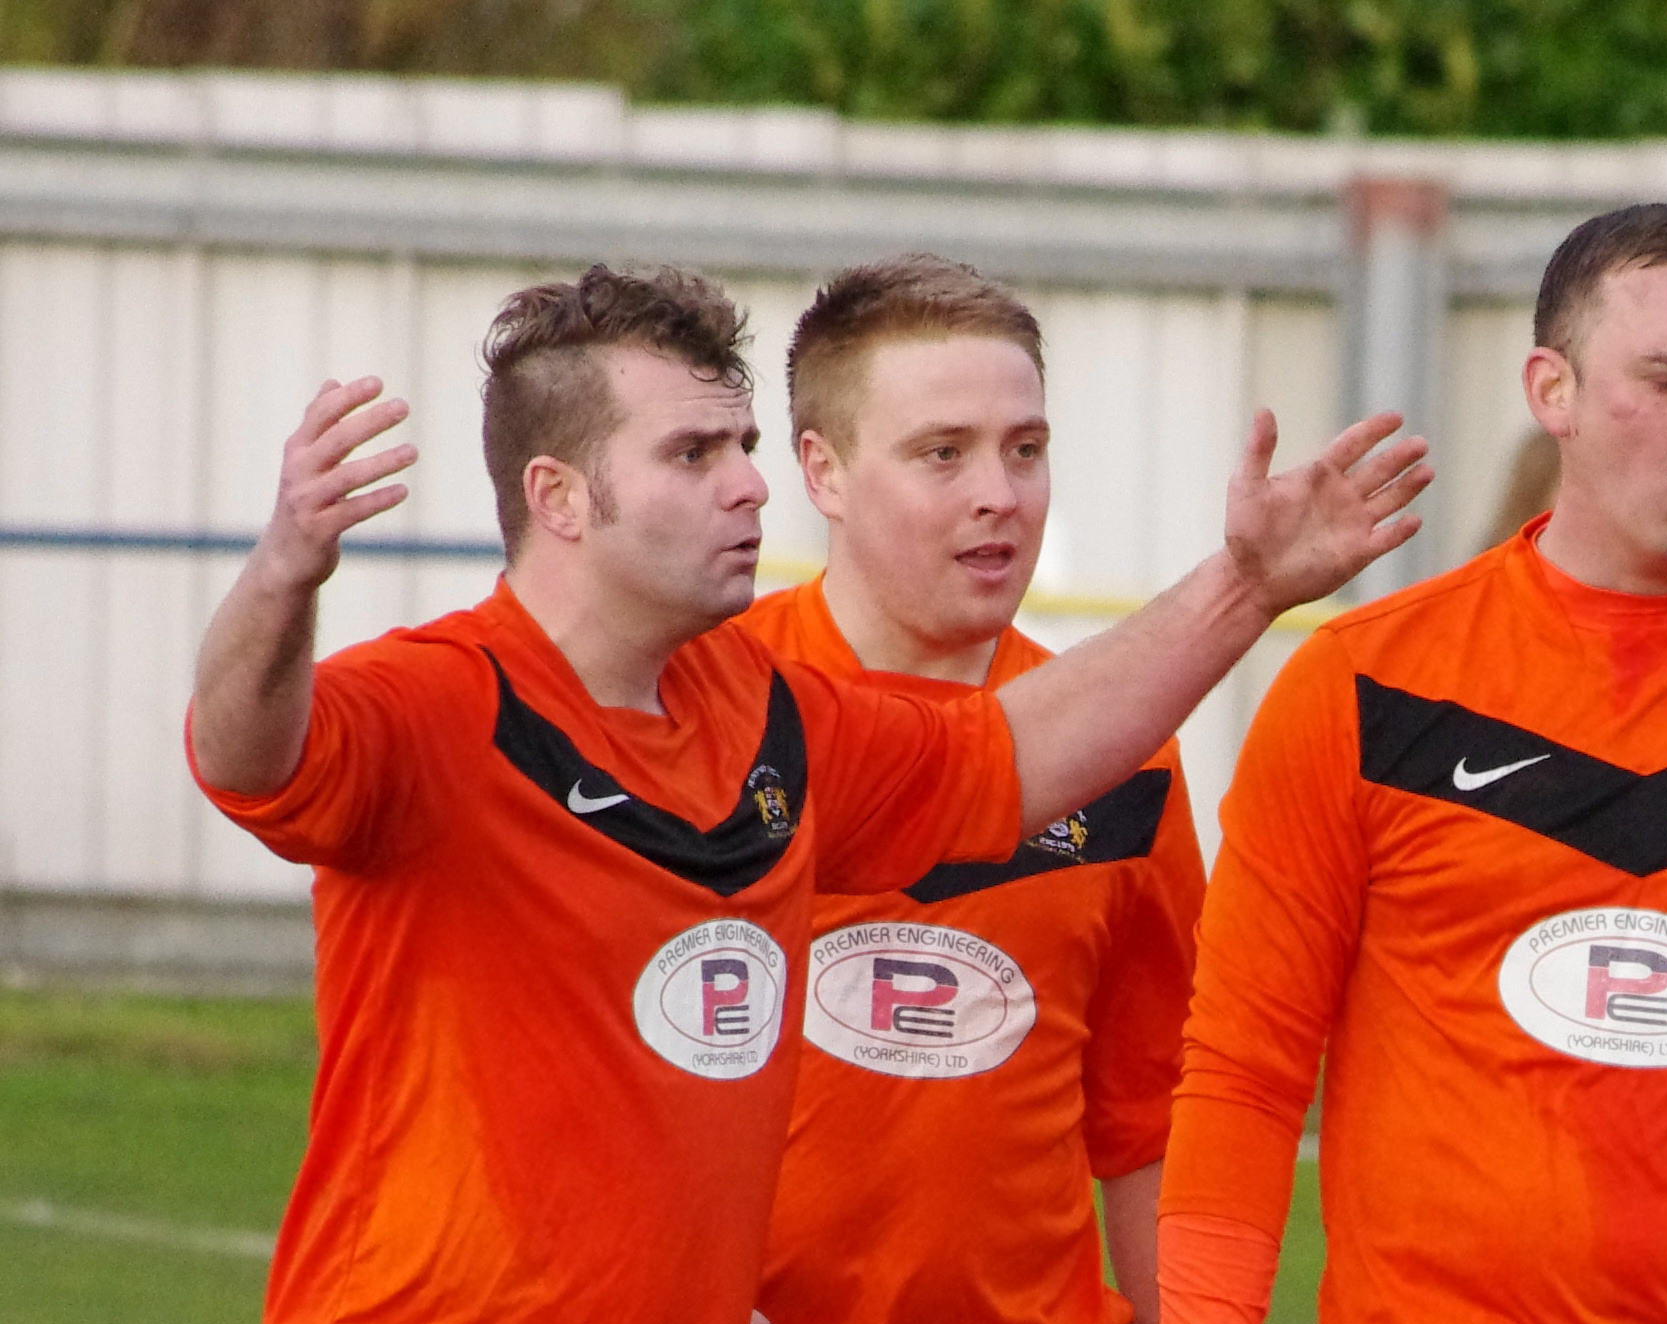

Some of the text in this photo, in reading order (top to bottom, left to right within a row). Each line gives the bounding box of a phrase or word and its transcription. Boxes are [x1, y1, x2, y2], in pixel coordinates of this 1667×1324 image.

[658, 927, 711, 975] PREMIER
[1529, 914, 1607, 953] PREMIER
[814, 927, 1015, 984] PREMIER ENGINEERING
[854, 1046, 968, 1069] (YORKSHIRE) LTD
[1567, 1034, 1654, 1056] (YORKSHIRE)
